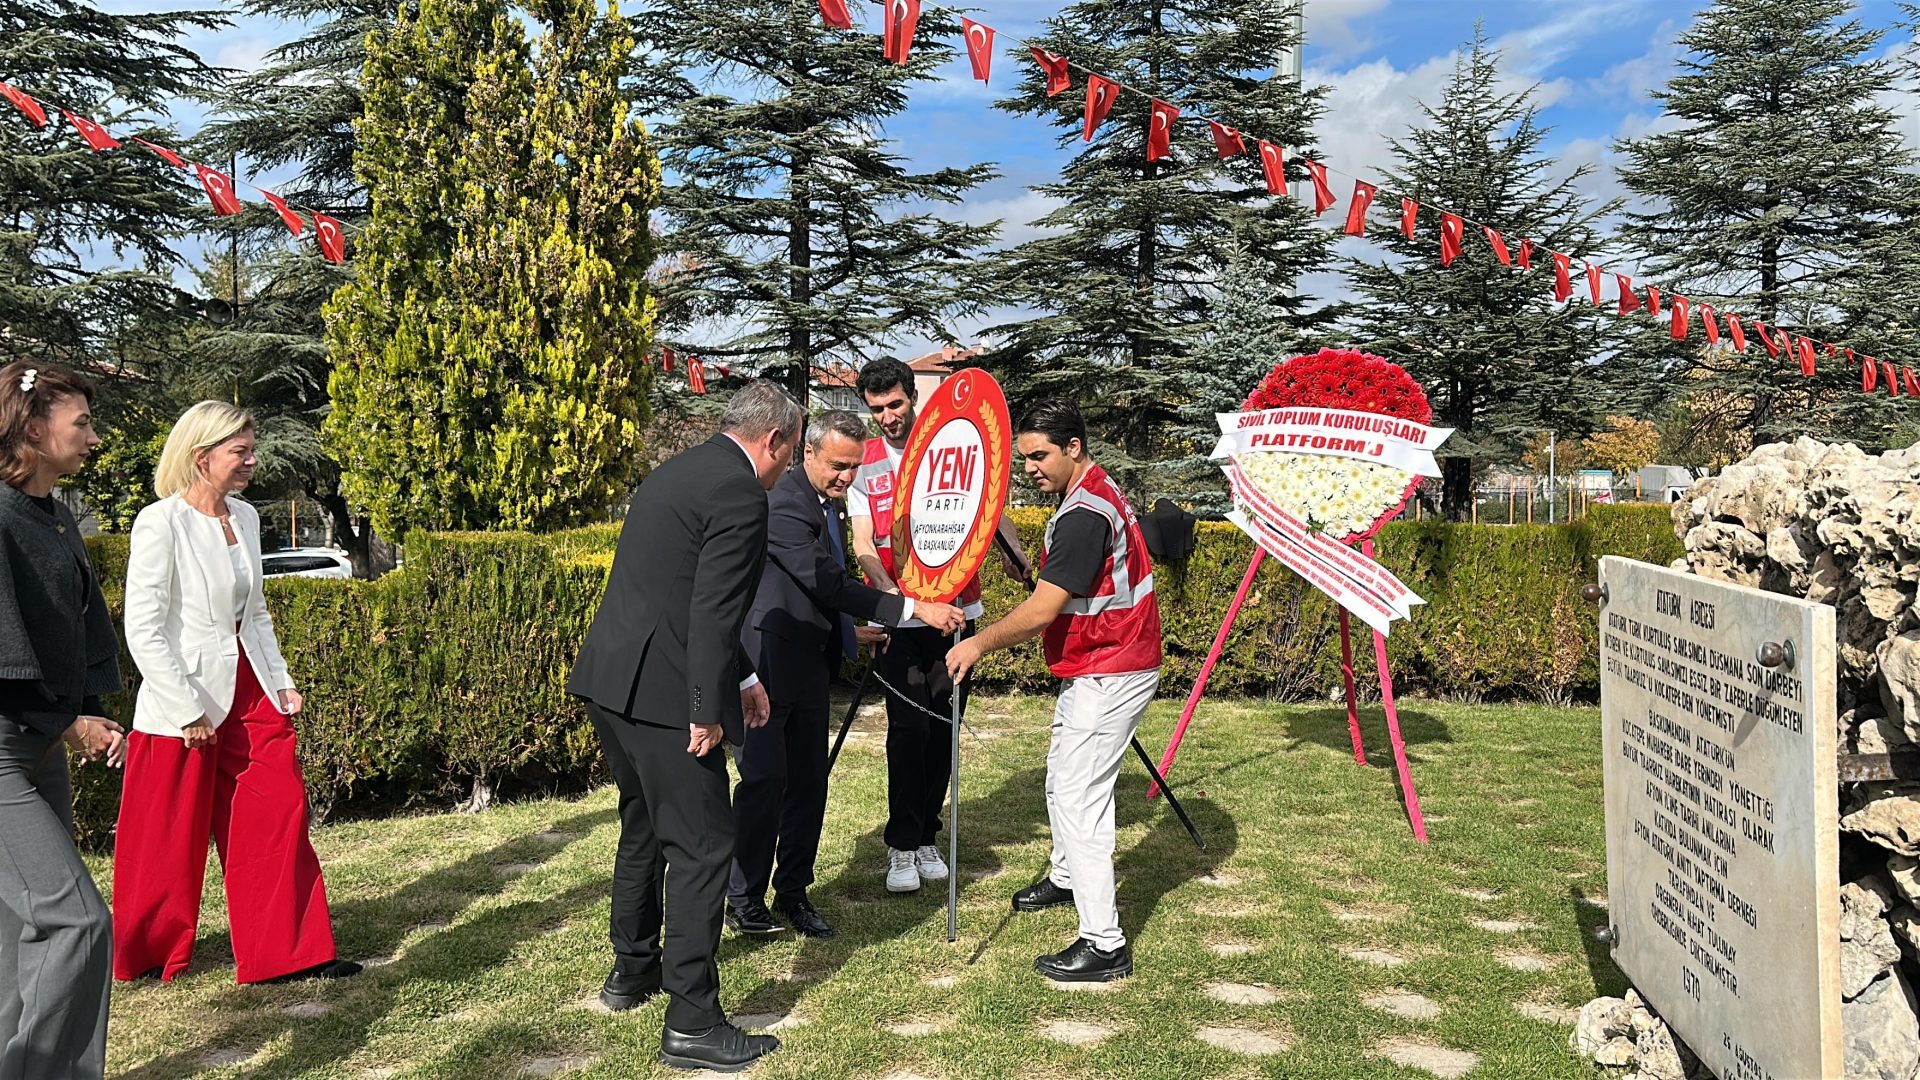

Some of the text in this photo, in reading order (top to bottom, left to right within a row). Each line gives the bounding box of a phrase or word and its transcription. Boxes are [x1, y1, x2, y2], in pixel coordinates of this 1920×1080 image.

[1237, 411, 1427, 444] SİVİL TOPLUM KURULUŞLARI
[927, 445, 978, 492] YENİ
[914, 521, 966, 534] AFYONKARAHİSAR
[926, 498, 965, 511] PARTİ
[1656, 588, 1715, 631] ATATÜRK ABİDESİ
[1622, 640, 1629, 658] VE
[1709, 677, 1721, 700] BİR
[1724, 683, 1753, 714] ZAFERLE
[1755, 694, 1803, 735] DÜĞÜMLEYEN
[1643, 624, 1671, 653] KURTULUŞ
[1673, 636, 1707, 666] SAVAŞINDA
[1709, 648, 1743, 680] DÜŞMANA
[1747, 662, 1763, 688] SON
[1765, 669, 1802, 703] DARBEYİ
[1648, 708, 1691, 748] BAŞKUMANDAN
[1695, 697, 1735, 734] YÖNETMİŞTİ
[1622, 718, 1774, 824] KOCATEPE MUHAREBE İDARE YERİNDEN YÖNETTİĞİ
[1622, 741, 1639, 765] BÜYÜK
[1639, 751, 1663, 781] TAARRUZ
[1704, 792, 1736, 830] HATIRASI
[1742, 816, 1775, 855] OLARAK
[1646, 779, 1663, 806] AFYON
[1680, 802, 1700, 832] TARİHİ
[1702, 817, 1737, 859] ANILARINA
[1654, 809, 1728, 880] KATKIDA BULUNMAK İÇİN
[1634, 818, 1757, 930] AFYON ATATÜRK ANITI YAPTIRMA DERNEĞİ
[1668, 868, 1715, 923] TARAFINDAN VE
[1655, 882, 1686, 922] ORGENERAL
[1707, 926, 1737, 966] TULUNAY
[1683, 965, 1700, 1003] 1970
